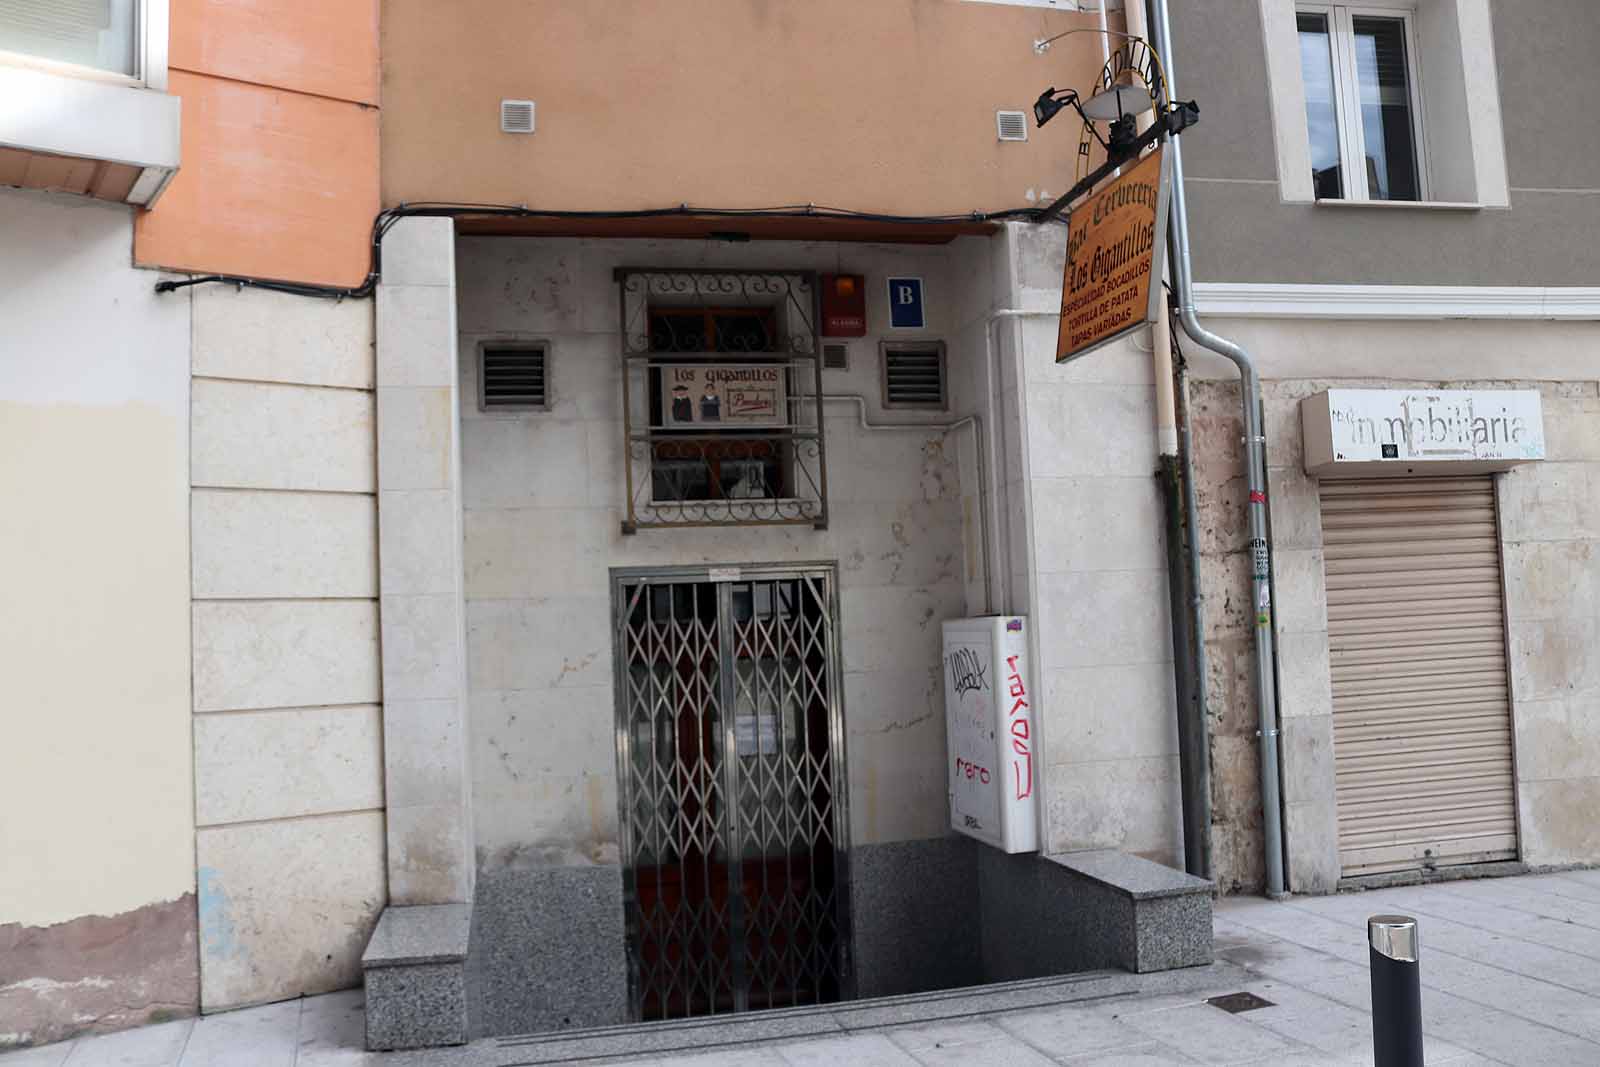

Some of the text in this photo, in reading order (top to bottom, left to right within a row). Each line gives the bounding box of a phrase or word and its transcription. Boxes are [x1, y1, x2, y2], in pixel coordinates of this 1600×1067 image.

[1068, 219, 1154, 294] Los Gigantillos
[898, 286, 912, 304] B
[1063, 259, 1150, 317] ESPECIALIDAD BOCADILLOS
[1068, 287, 1138, 331] TORTILLA DE PATATA
[1071, 328, 1092, 348] TAPAS
